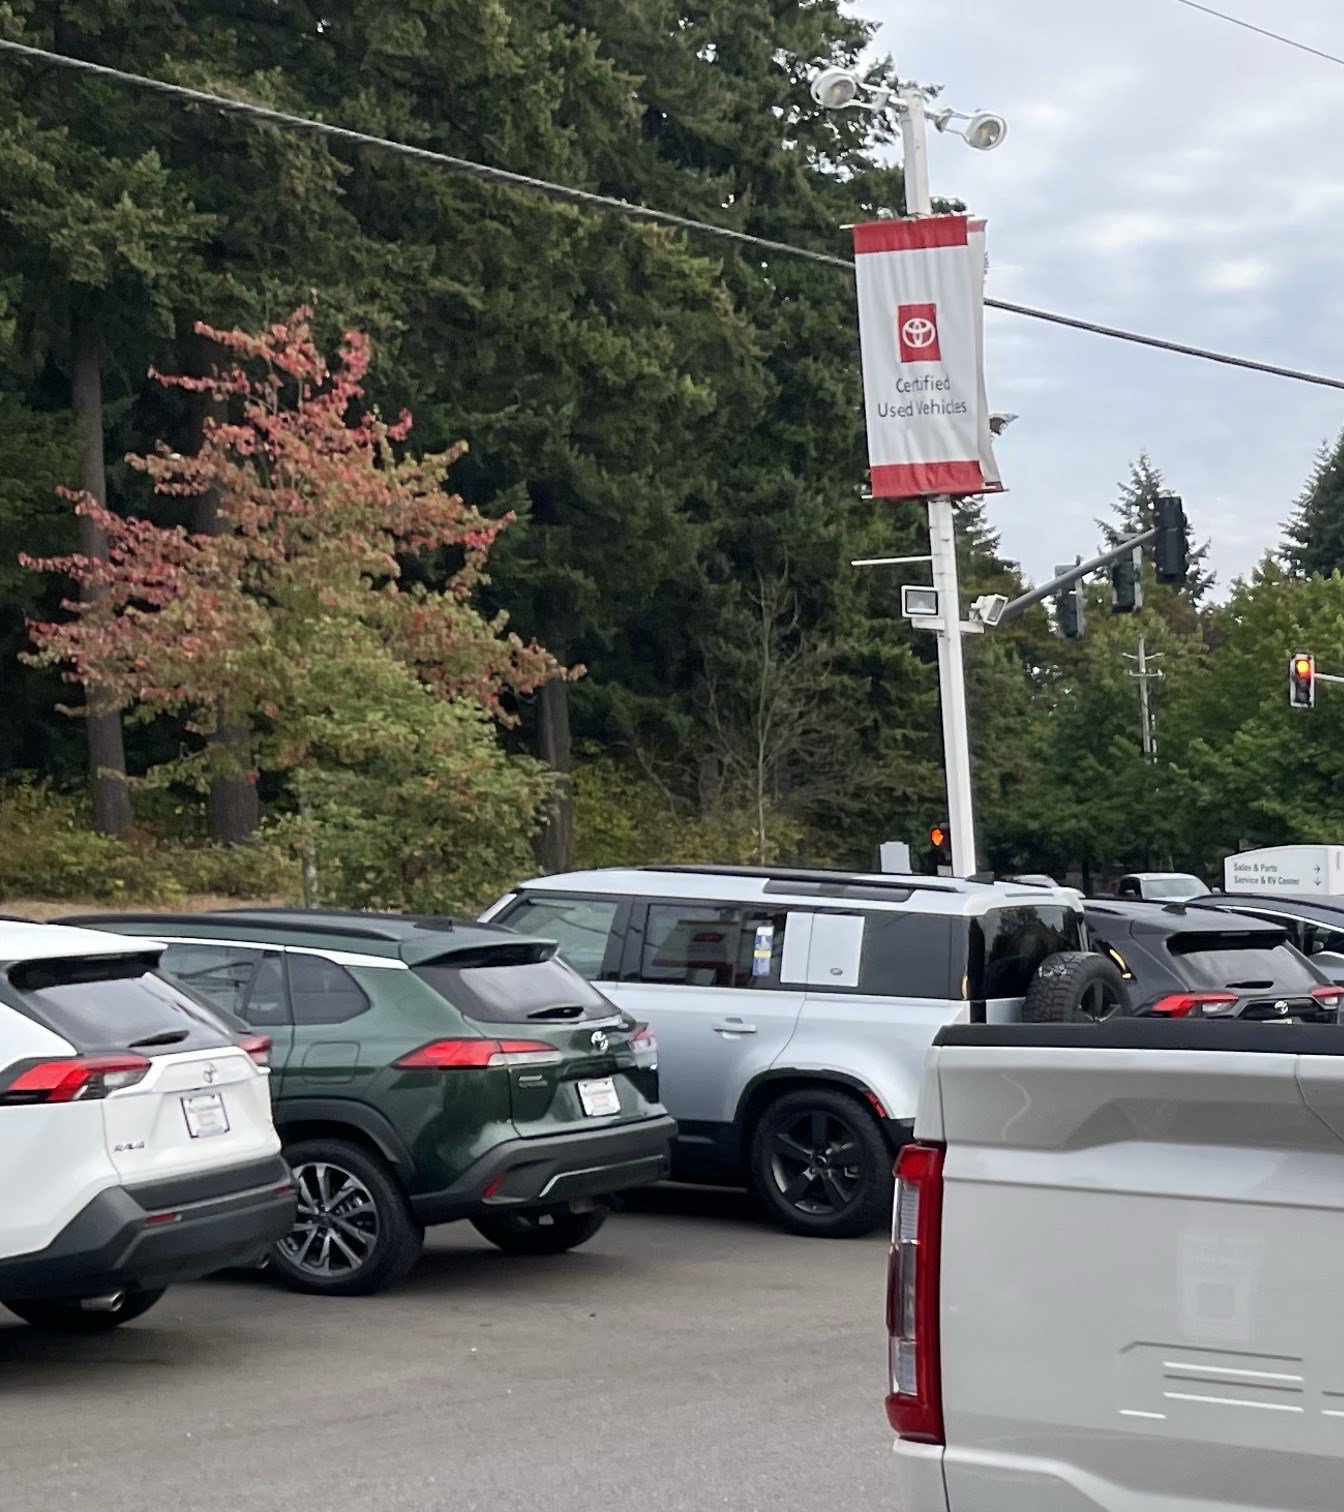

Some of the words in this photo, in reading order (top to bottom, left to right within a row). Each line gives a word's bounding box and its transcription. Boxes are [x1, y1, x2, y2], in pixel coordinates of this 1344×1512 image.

[896, 374, 951, 394] Certified
[877, 401, 914, 418] Used
[916, 398, 967, 416] Vehicles
[1233, 863, 1252, 872] Sales
